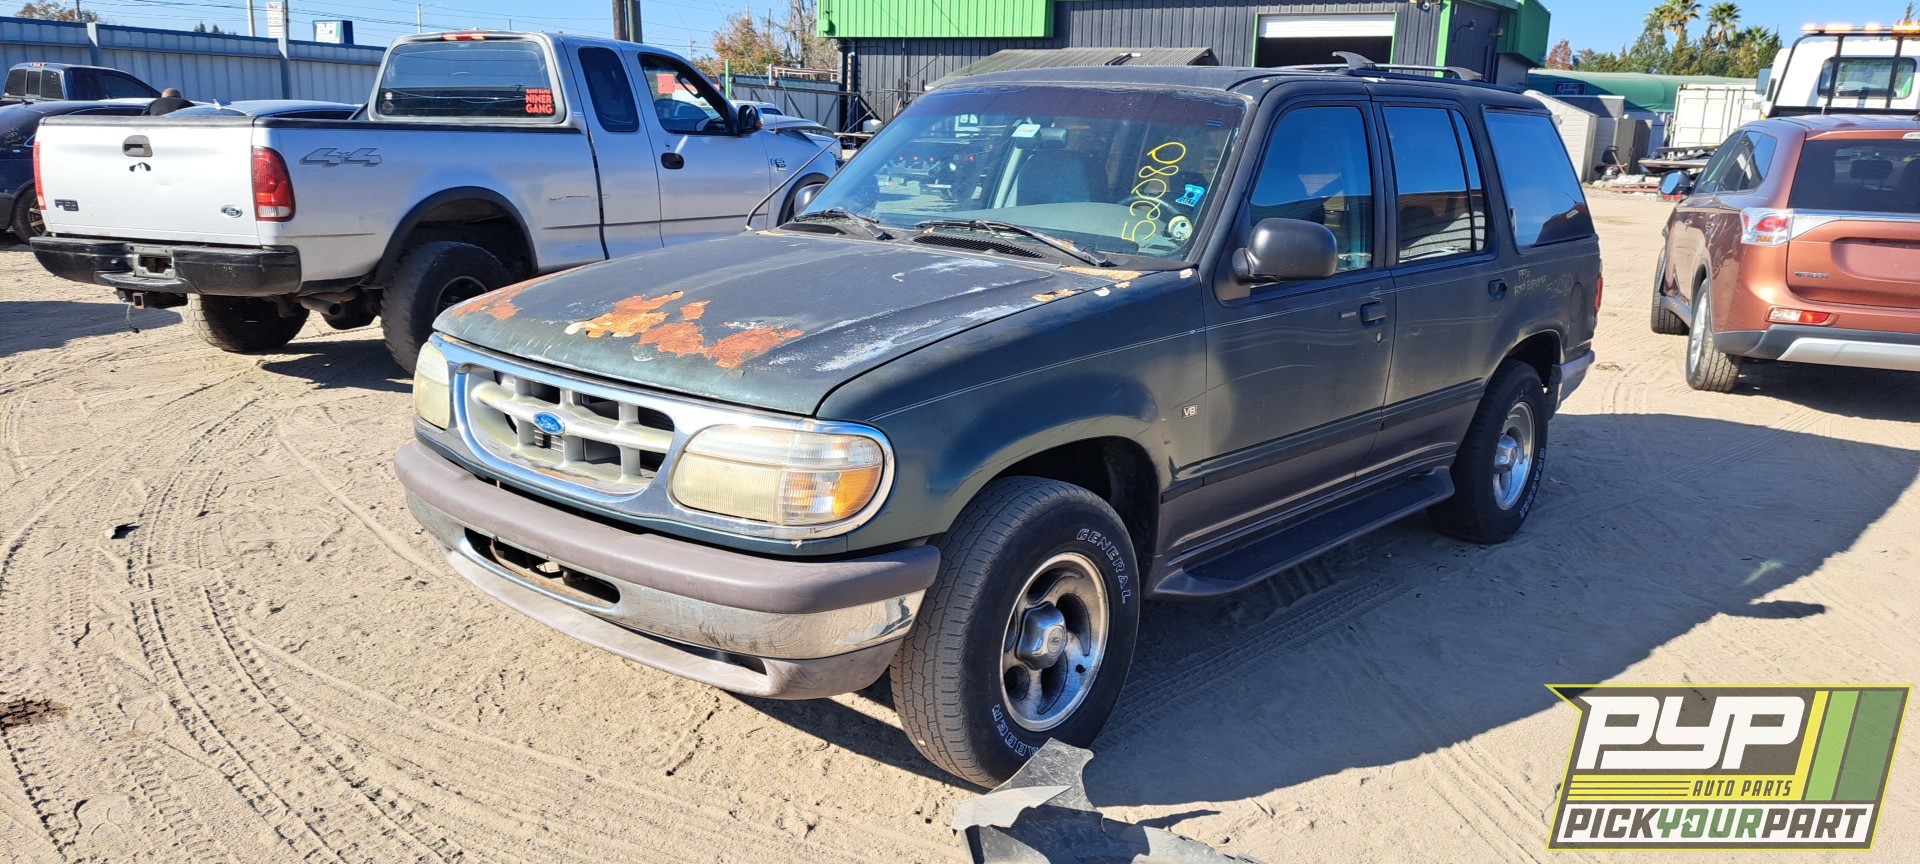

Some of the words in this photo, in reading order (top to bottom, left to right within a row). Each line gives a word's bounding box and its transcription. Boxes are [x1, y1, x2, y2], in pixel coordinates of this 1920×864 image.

[526, 94, 552, 104] NINER
[526, 104, 553, 114] GANG
[299, 148, 382, 167] 4x4
[1121, 142, 1186, 242] 52080
[536, 414, 562, 432] Ford
[1076, 528, 1132, 605] GENERAL
[991, 703, 1040, 758] ABBER
